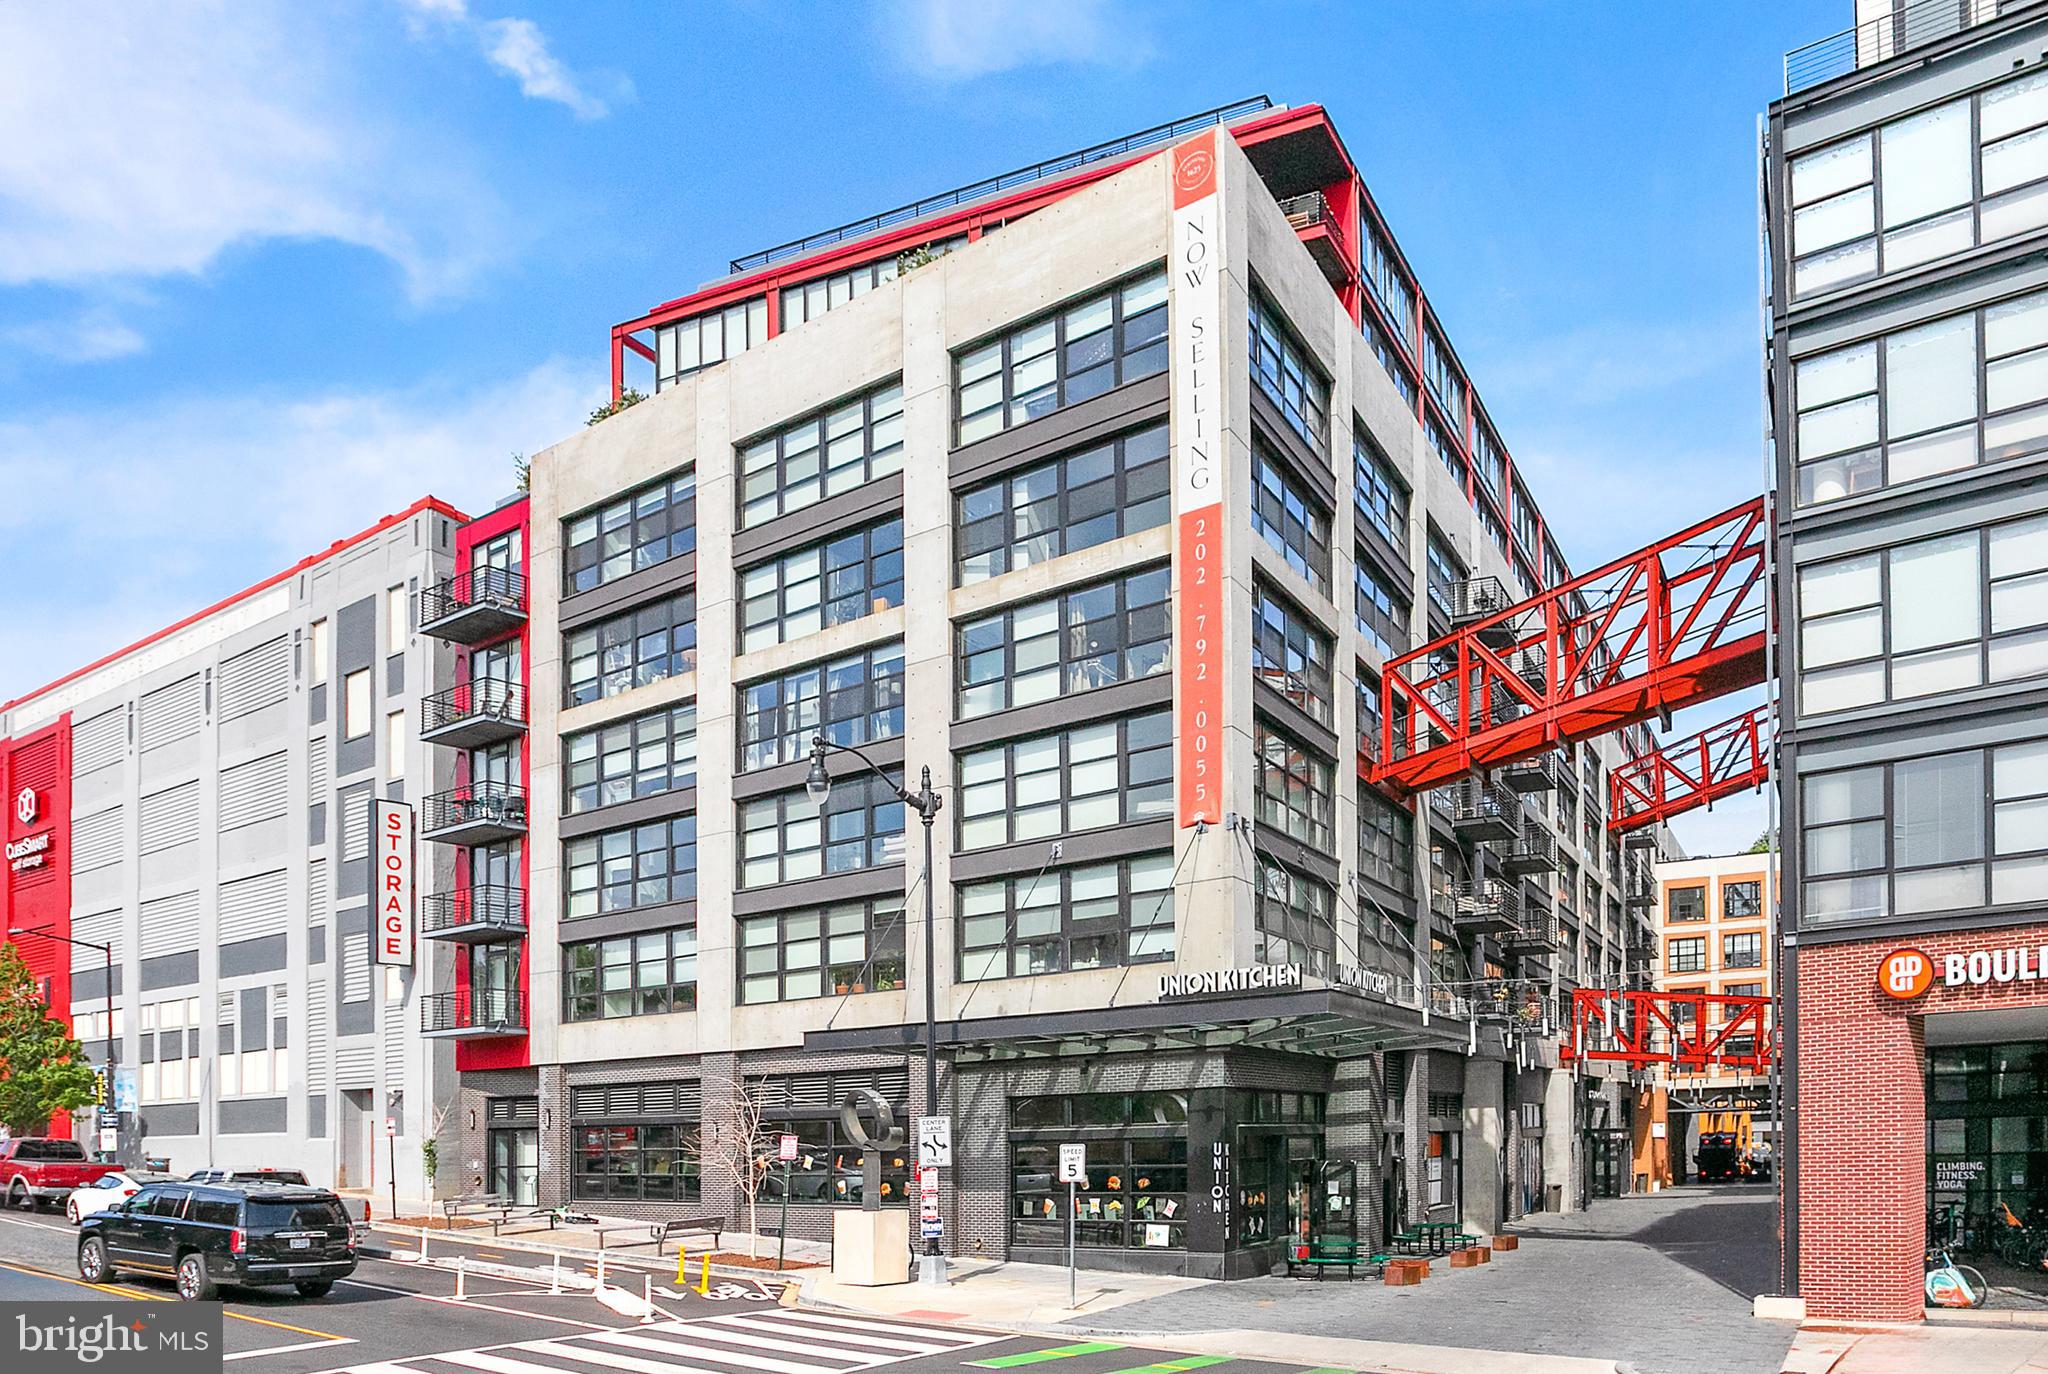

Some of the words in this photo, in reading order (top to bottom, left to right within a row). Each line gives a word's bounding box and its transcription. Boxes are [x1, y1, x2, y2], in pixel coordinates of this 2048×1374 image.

[1185, 215, 1208, 289] NOW
[1190, 316, 1210, 491] SELLING
[1195, 519, 1207, 802] 202.792.0055
[386, 813, 402, 955] STORAGE
[1157, 971, 1218, 997] UNION
[1218, 962, 1301, 993] KITCHEN
[1340, 963, 1362, 990] UNION
[1362, 969, 1388, 995] KITCHEN
[1068, 1164, 1077, 1177] 5
[1211, 1142, 1224, 1213] UNION
[1936, 1161, 1986, 1171] CLIMBING.
[1936, 1170, 1978, 1180] FITNESS.
[1936, 1180, 1966, 1189] YOGA.
